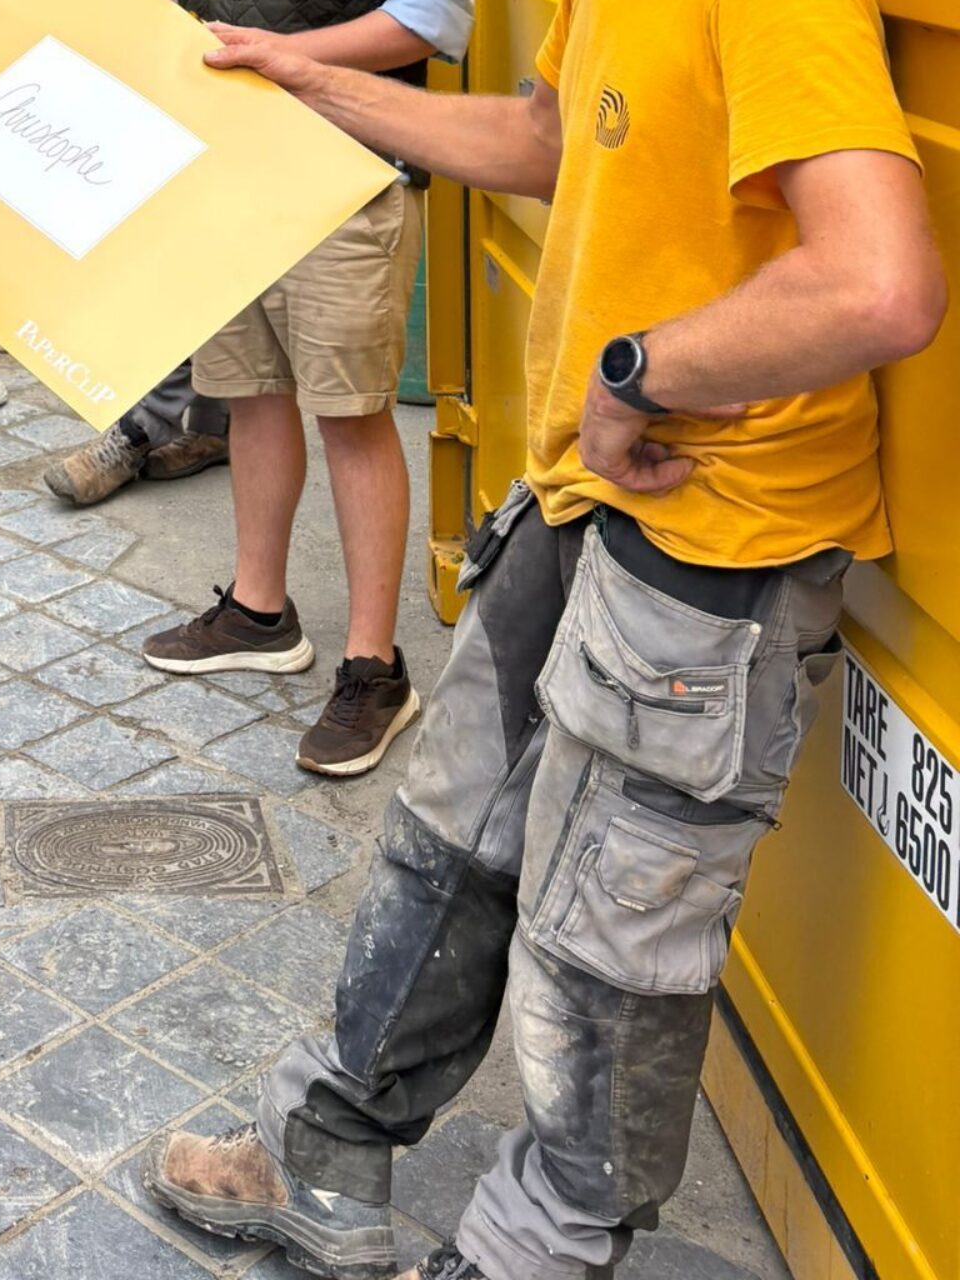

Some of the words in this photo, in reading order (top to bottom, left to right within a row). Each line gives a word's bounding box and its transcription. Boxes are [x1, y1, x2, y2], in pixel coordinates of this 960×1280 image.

[844, 724, 877, 819] NET
[895, 791, 951, 912] 6500
[845, 656, 888, 762] TARE
[911, 732, 953, 836] 825
